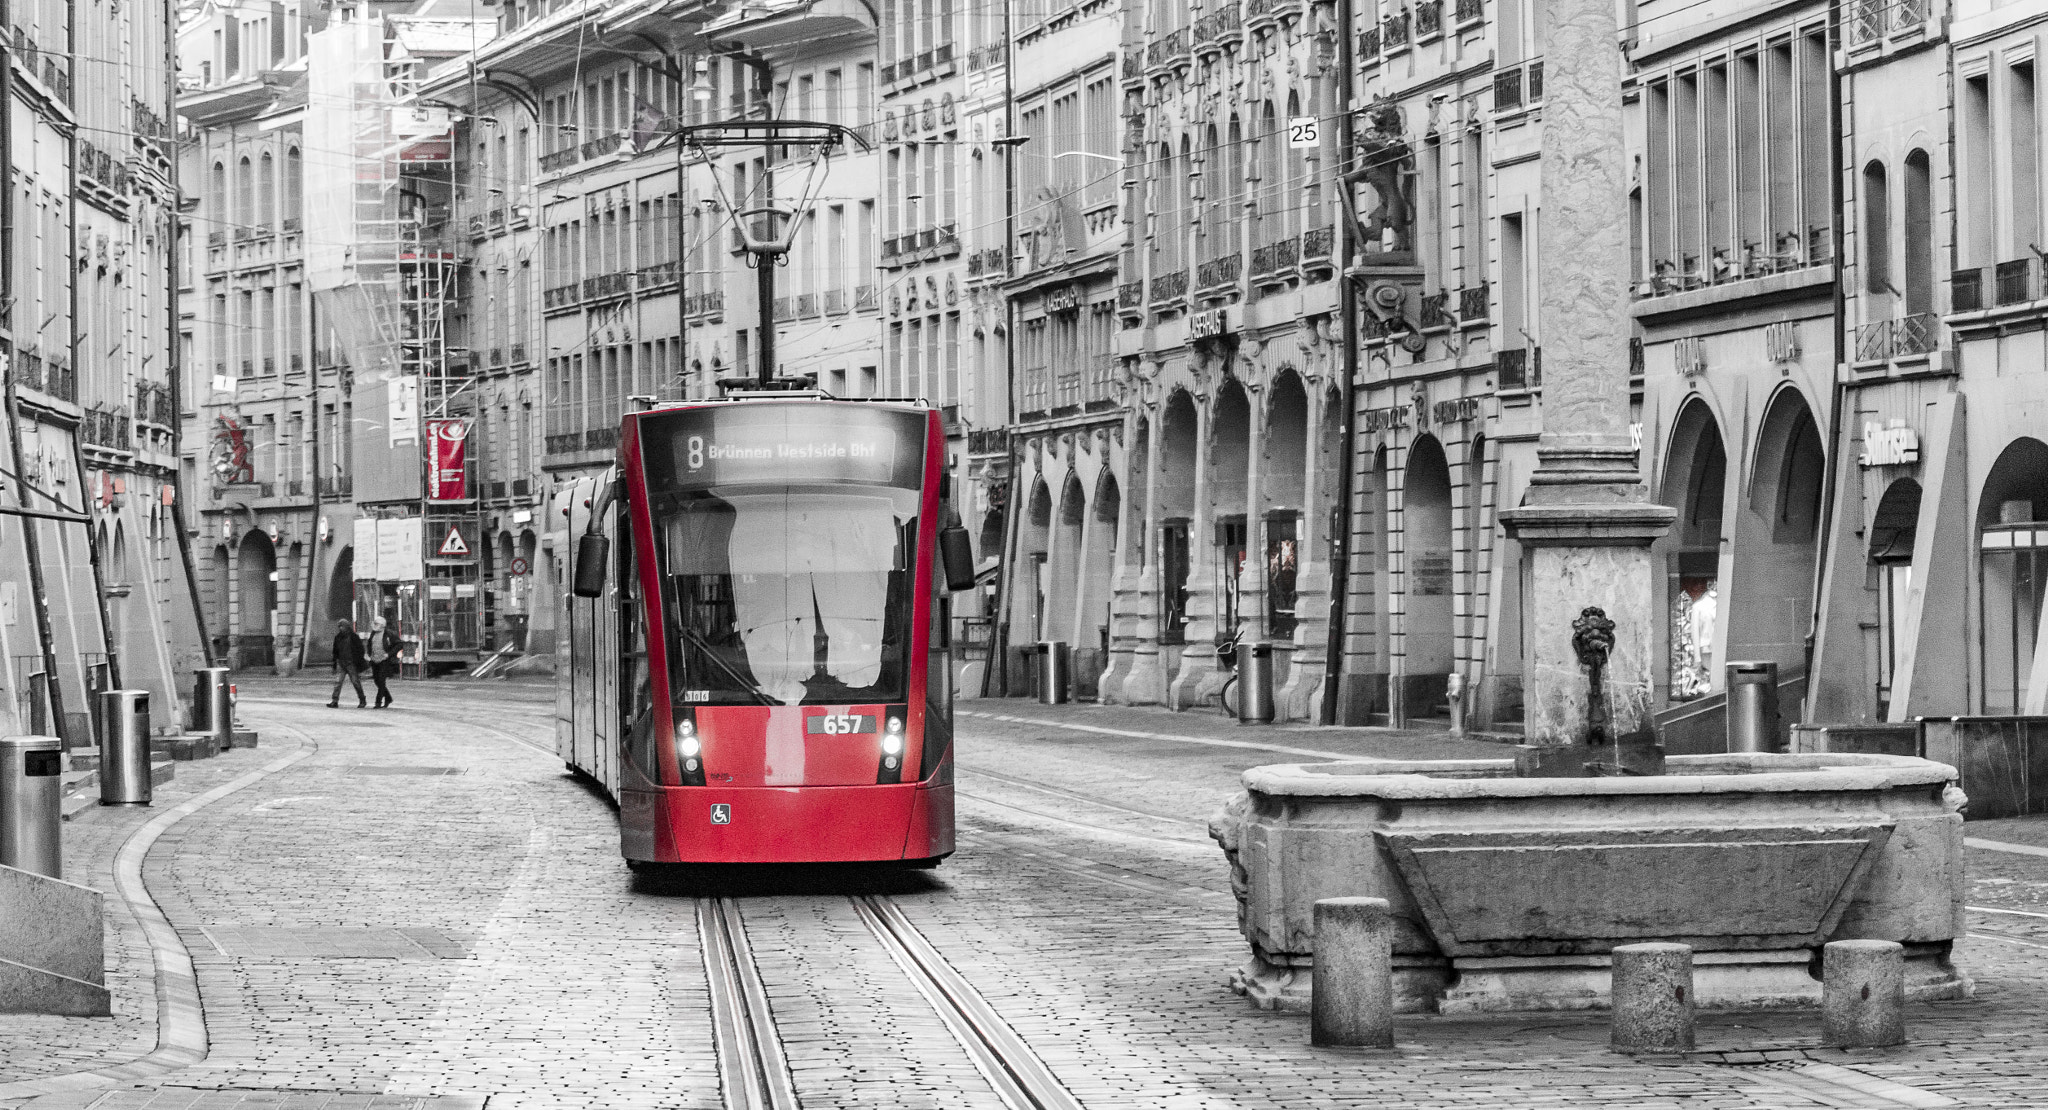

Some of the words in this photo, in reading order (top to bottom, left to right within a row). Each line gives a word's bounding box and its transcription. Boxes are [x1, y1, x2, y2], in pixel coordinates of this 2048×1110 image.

[1291, 124, 1317, 142] 25
[688, 436, 703, 469] 8
[708, 444, 773, 459] Brünnen
[778, 443, 846, 458] Westside
[850, 442, 876, 457] Bhf
[823, 714, 863, 735] 657
